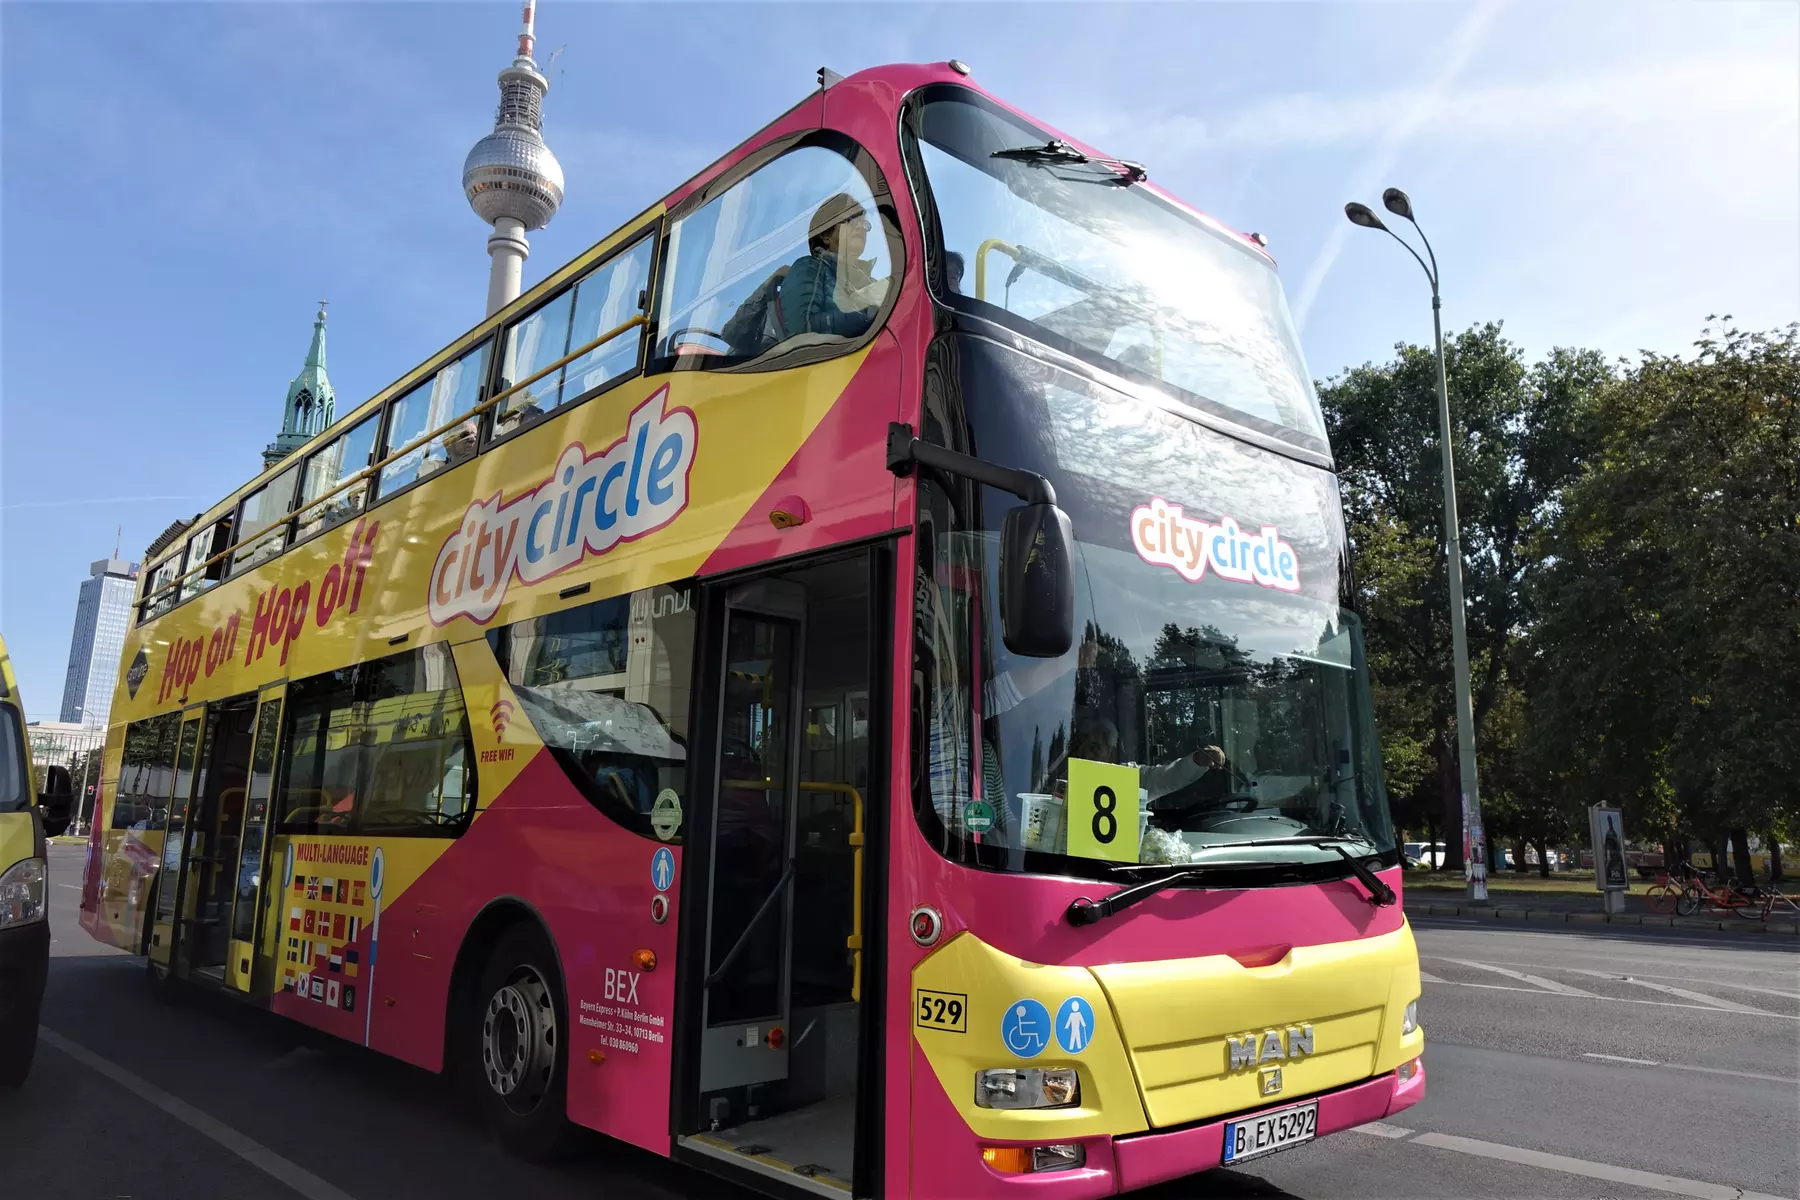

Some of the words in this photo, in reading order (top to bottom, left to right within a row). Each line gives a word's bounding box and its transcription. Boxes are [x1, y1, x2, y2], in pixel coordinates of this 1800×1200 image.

[158, 635, 203, 704] Hop
[204, 608, 242, 678] on
[244, 579, 311, 667] Hop
[315, 516, 380, 627] off
[480, 750, 498, 763] FREE
[499, 748, 515, 761] WIFI
[1092, 785, 1117, 844] 8
[296, 842, 369, 866] MULTI-LANGUAGE
[604, 968, 640, 1005] BEX
[580, 999, 596, 1012] Bayern
[596, 1003, 613, 1016] Express
[633, 1011, 649, 1024] Berlin
[648, 1014, 664, 1027] GmbH
[920, 997, 963, 1025] 529
[579, 1014, 607, 1029] Mannheimer
[607, 1020, 616, 1032] Str.
[633, 1027, 648, 1040] 10713
[648, 1030, 664, 1043] Berlin
[600, 1035, 609, 1046] Tel.
[609, 1037, 619, 1049] 030
[1227, 1023, 1314, 1070] MAN
[1235, 1126, 1246, 1154] B
